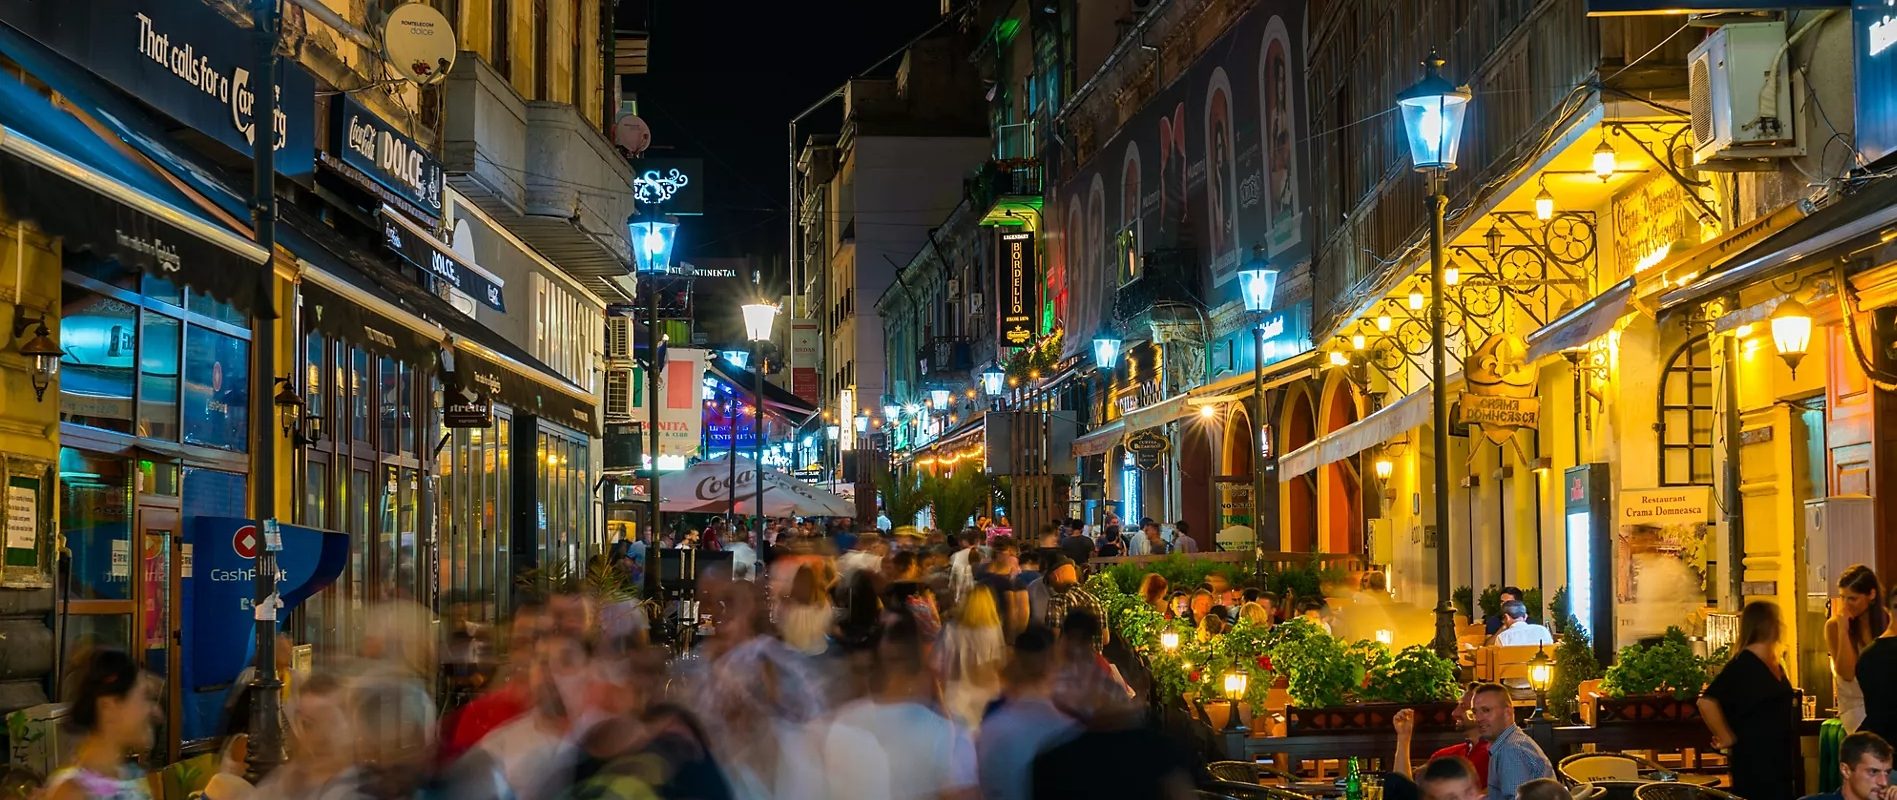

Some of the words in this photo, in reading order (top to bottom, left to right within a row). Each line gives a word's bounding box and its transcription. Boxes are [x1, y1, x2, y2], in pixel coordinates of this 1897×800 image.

[135, 12, 169, 68] That
[171, 43, 200, 87] calls
[200, 55, 219, 97] for
[220, 76, 228, 104] a
[383, 131, 424, 190] DOLCE
[432, 250, 457, 281] DOLCE
[1013, 242, 1021, 314] BORDELLO
[1626, 507, 1653, 517] Crama
[1655, 505, 1702, 516] Domneasca
[1641, 495, 1686, 504] Restaurant
